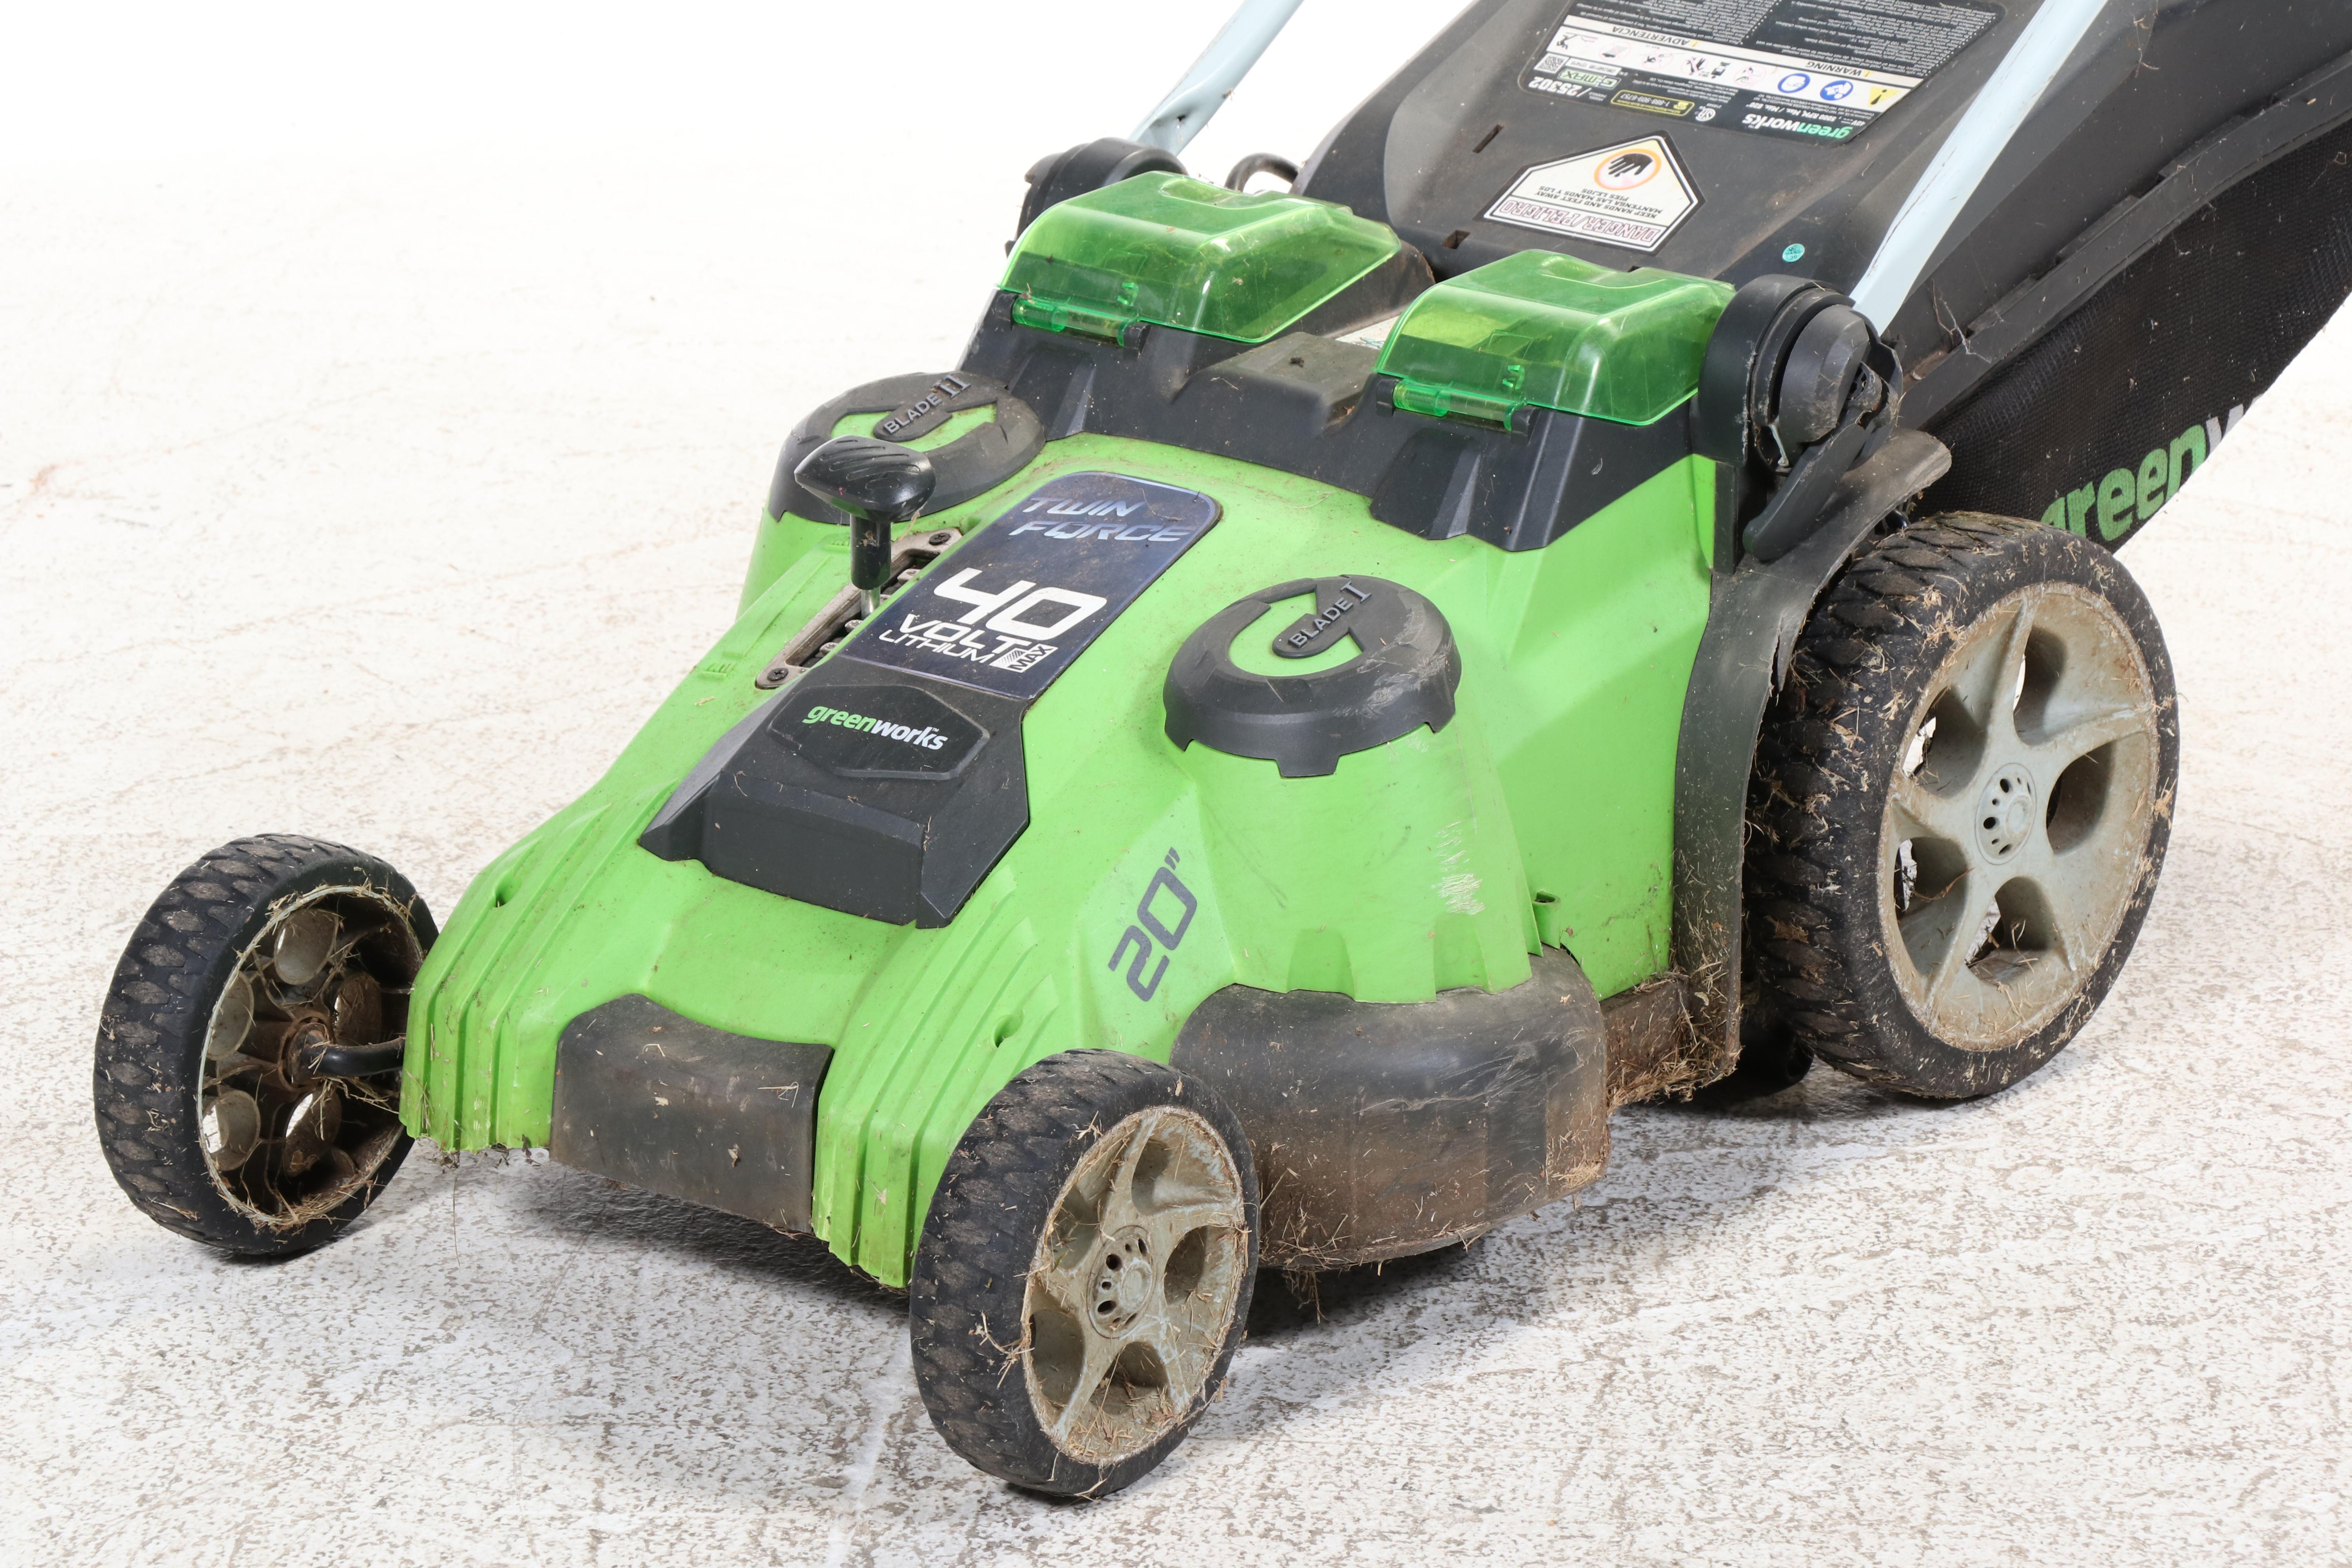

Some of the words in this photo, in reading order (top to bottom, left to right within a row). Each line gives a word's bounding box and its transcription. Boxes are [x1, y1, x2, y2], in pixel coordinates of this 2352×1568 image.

[1612, 26, 1690, 46] ADVERTENCIA
[1806, 62, 1862, 76] WARNING
[1620, 93, 1670, 107] 1-888-909-6757
[1535, 191, 1560, 199] AWAY
[1560, 196, 1583, 204] FEET
[1564, 191, 1595, 201] MANOS
[1581, 189, 1608, 198] LEJOS
[1603, 205, 1633, 214] HANDS
[1614, 201, 1662, 214] MANTENGA
[1500, 200, 1661, 242] DANGER/PELIGRO
[883, 393, 942, 435] BLADE
[1023, 496, 1149, 518] TWIN
[1008, 521, 1194, 542] FORCE
[933, 567, 1107, 640] 40
[1288, 597, 1354, 649] BLADE
[1340, 581, 1372, 604] I
[898, 613, 1032, 651] VOLT
[878, 628, 996, 663] LITHIUM
[1007, 646, 1054, 671] MAX
[1108, 846, 1198, 1002] 20"
